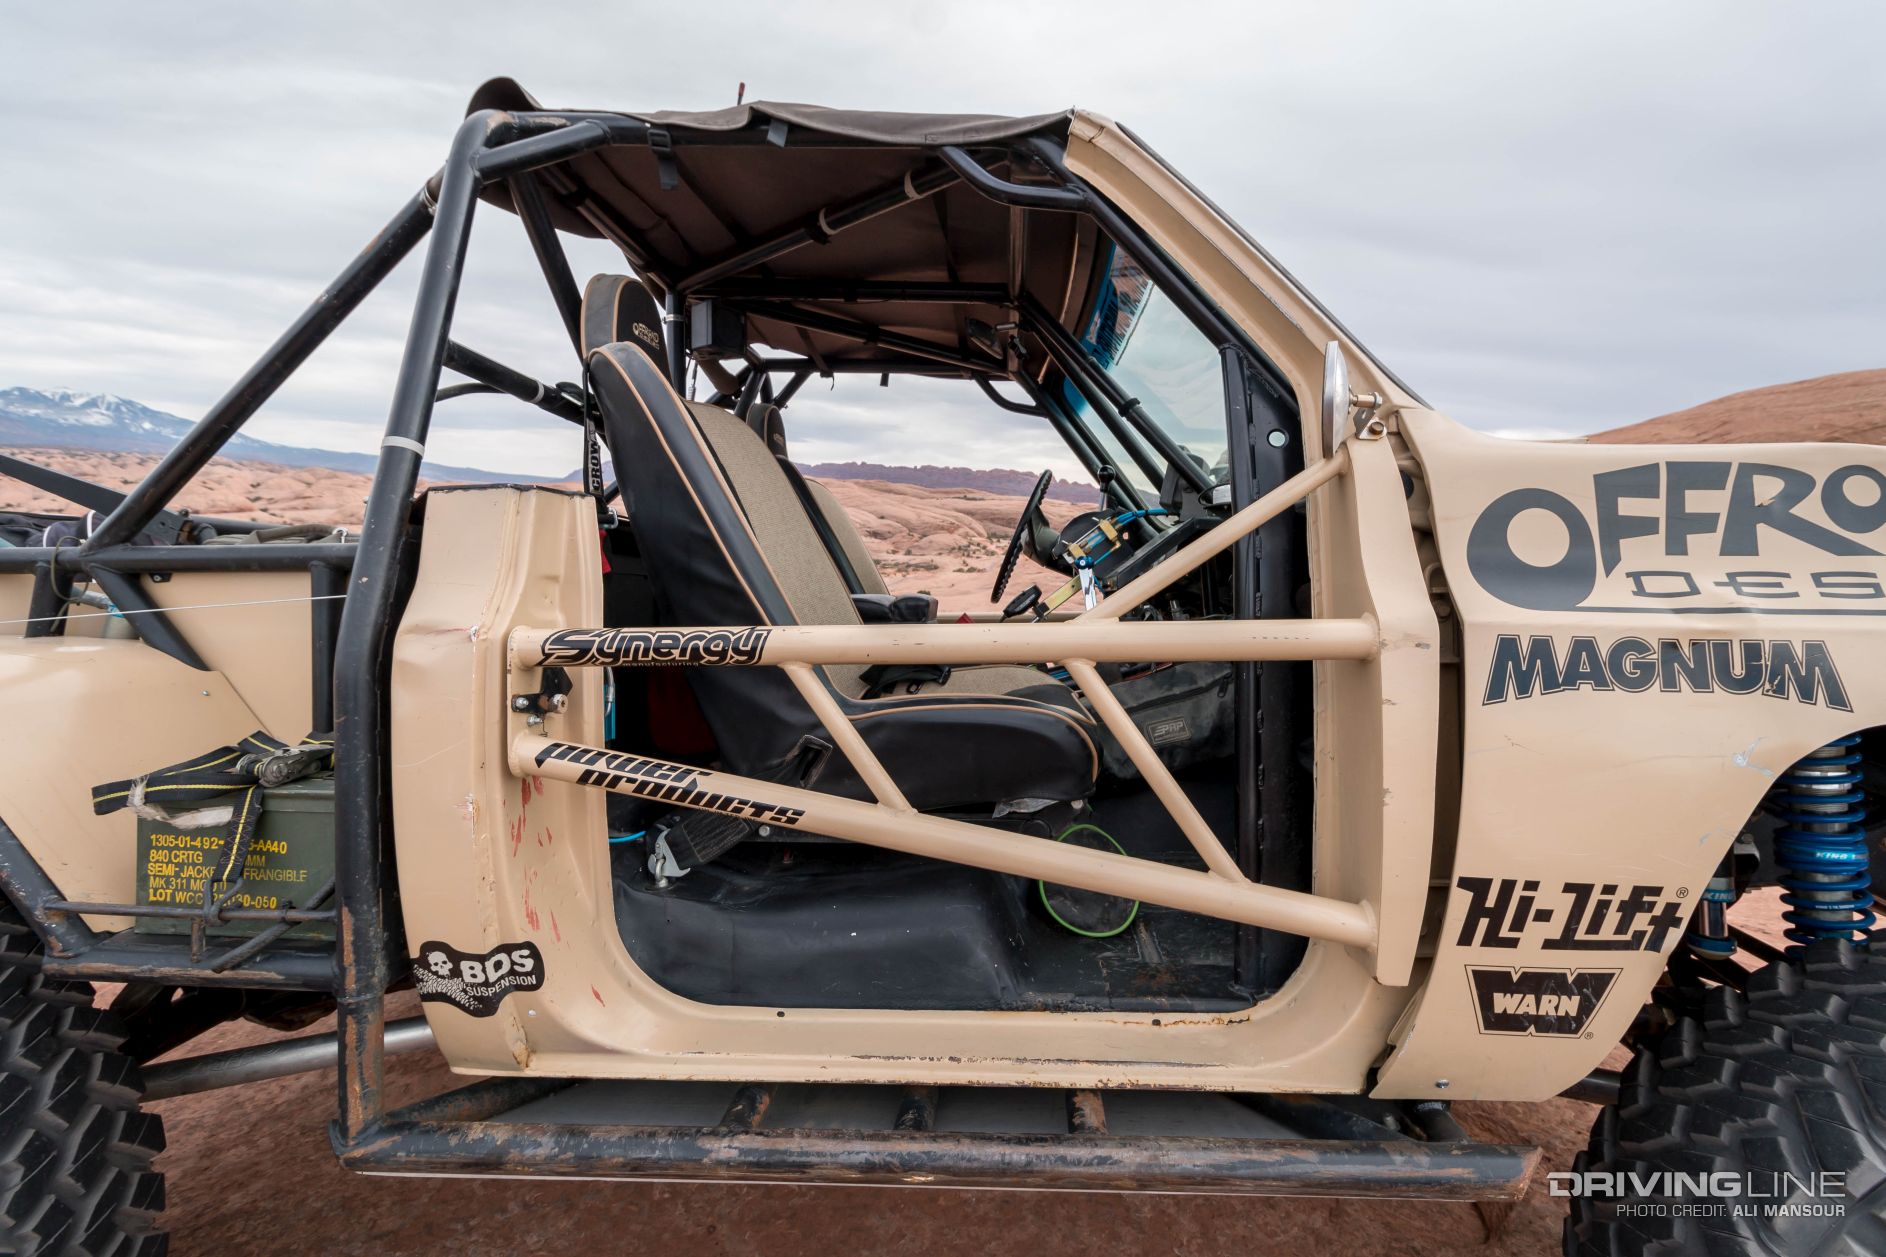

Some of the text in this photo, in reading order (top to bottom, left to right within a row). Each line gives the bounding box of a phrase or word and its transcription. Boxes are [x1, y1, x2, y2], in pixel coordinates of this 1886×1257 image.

[537, 625, 773, 666] Synergy
[1482, 633, 1854, 713] MAGNUM
[150, 849, 169, 862] 840
[171, 850, 203, 863] CRTG
[147, 863, 179, 876] SEMI-
[243, 868, 308, 882] FRANGIBLE
[169, 878, 187, 889] 311
[149, 888, 172, 901] LOT
[459, 949, 535, 984] BDS
[466, 974, 537, 997] SUSPENSION
[1493, 992, 1581, 1017] WARN
